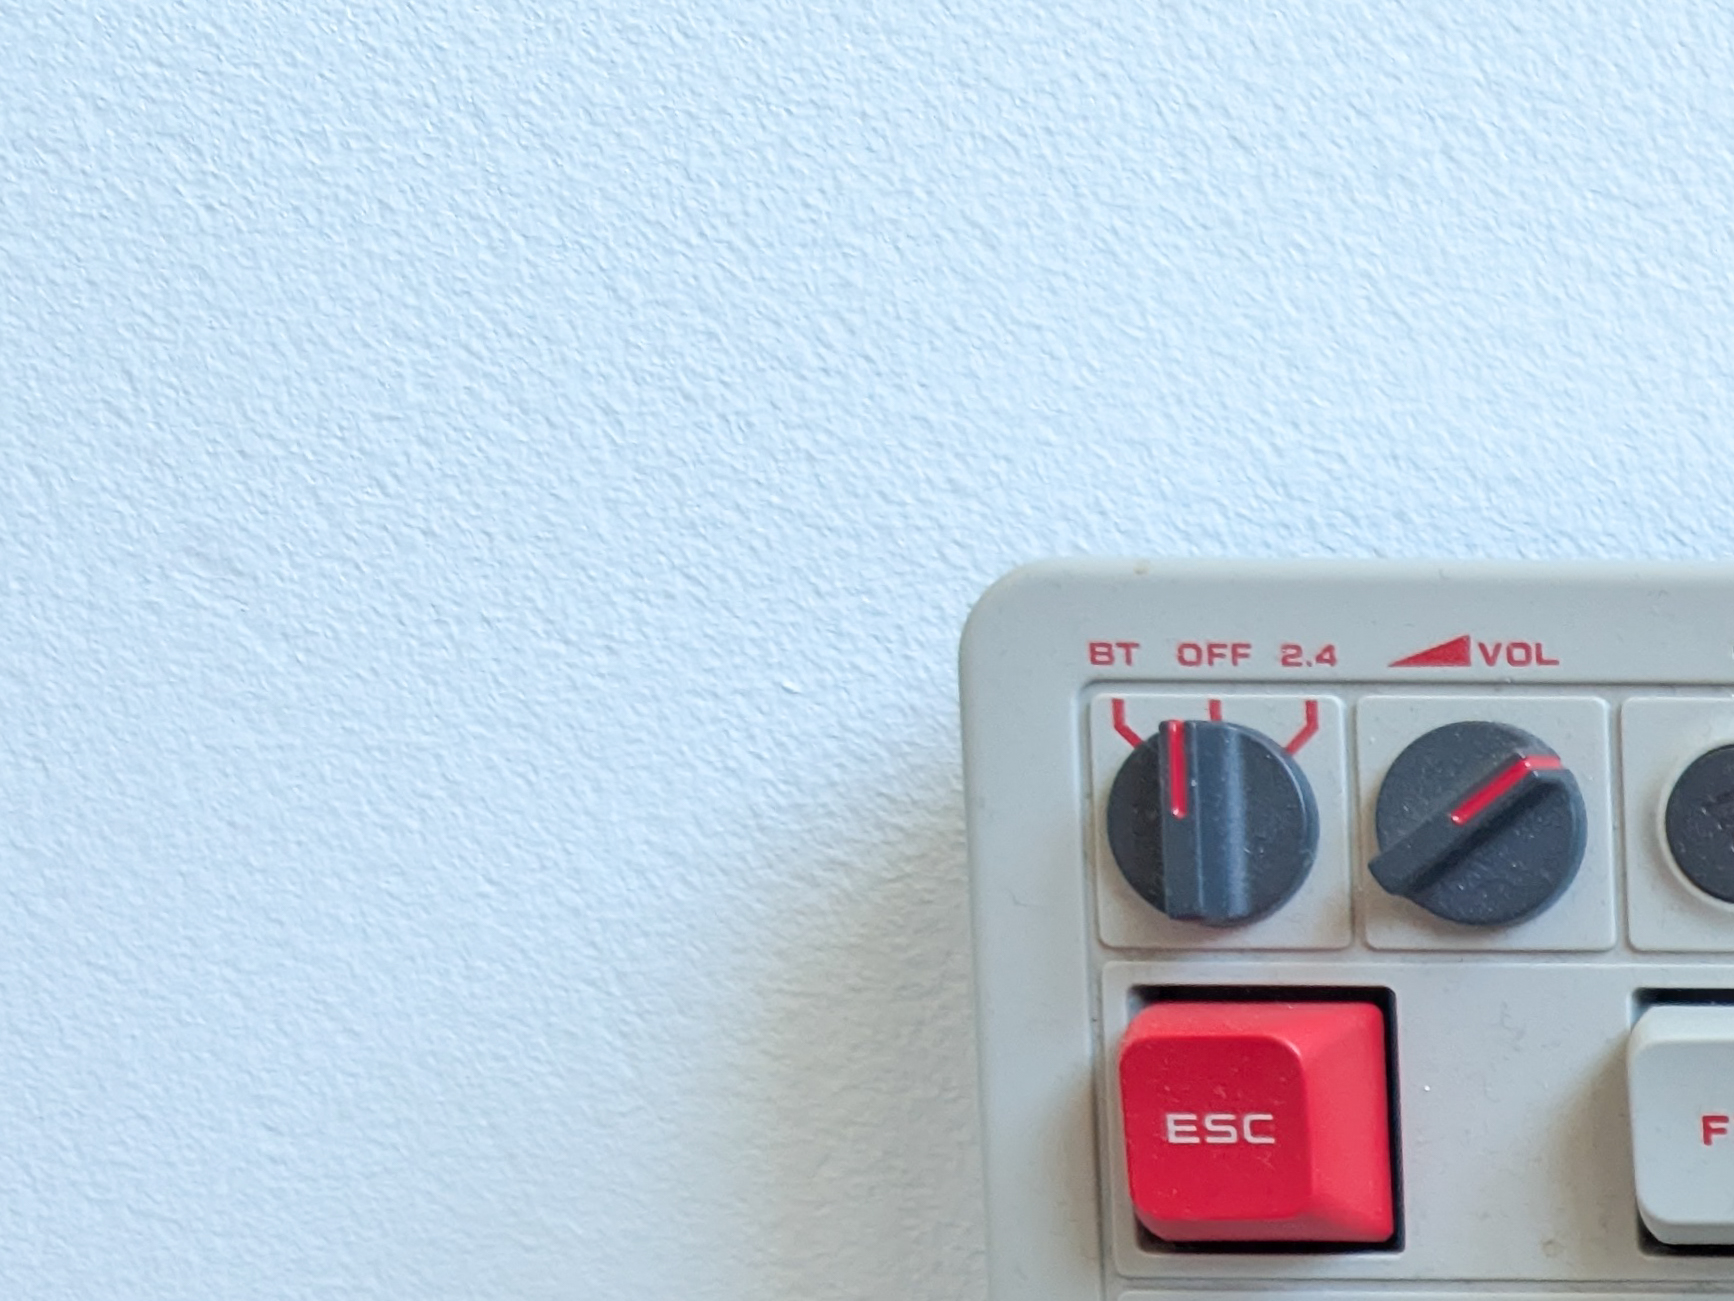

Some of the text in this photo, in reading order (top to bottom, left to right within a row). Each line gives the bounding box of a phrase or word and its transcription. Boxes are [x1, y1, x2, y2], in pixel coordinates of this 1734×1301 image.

[1088, 641, 1338, 667] BT OFF 2.4
[1477, 642, 1559, 667] VOL
[1166, 1112, 1276, 1144] ESC
